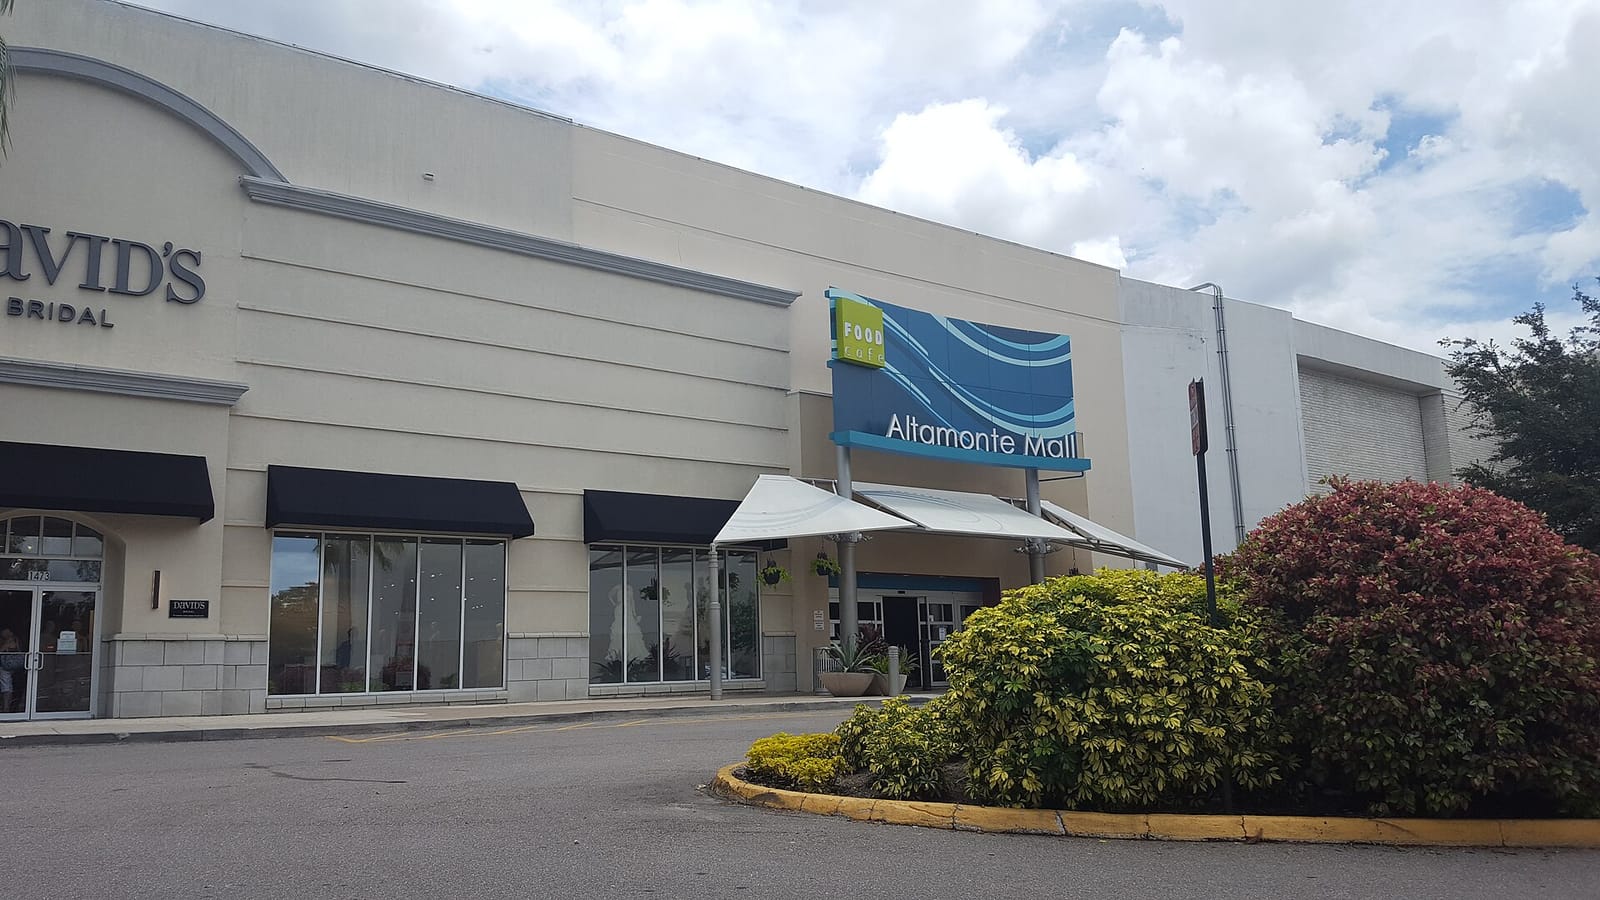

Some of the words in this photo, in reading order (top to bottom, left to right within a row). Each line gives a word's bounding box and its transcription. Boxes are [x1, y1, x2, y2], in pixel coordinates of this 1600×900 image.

[7, 296, 114, 329] BRIDAL
[844, 321, 883, 345] FOOD
[886, 413, 1015, 454] Altamonte
[1023, 432, 1077, 458] Mall
